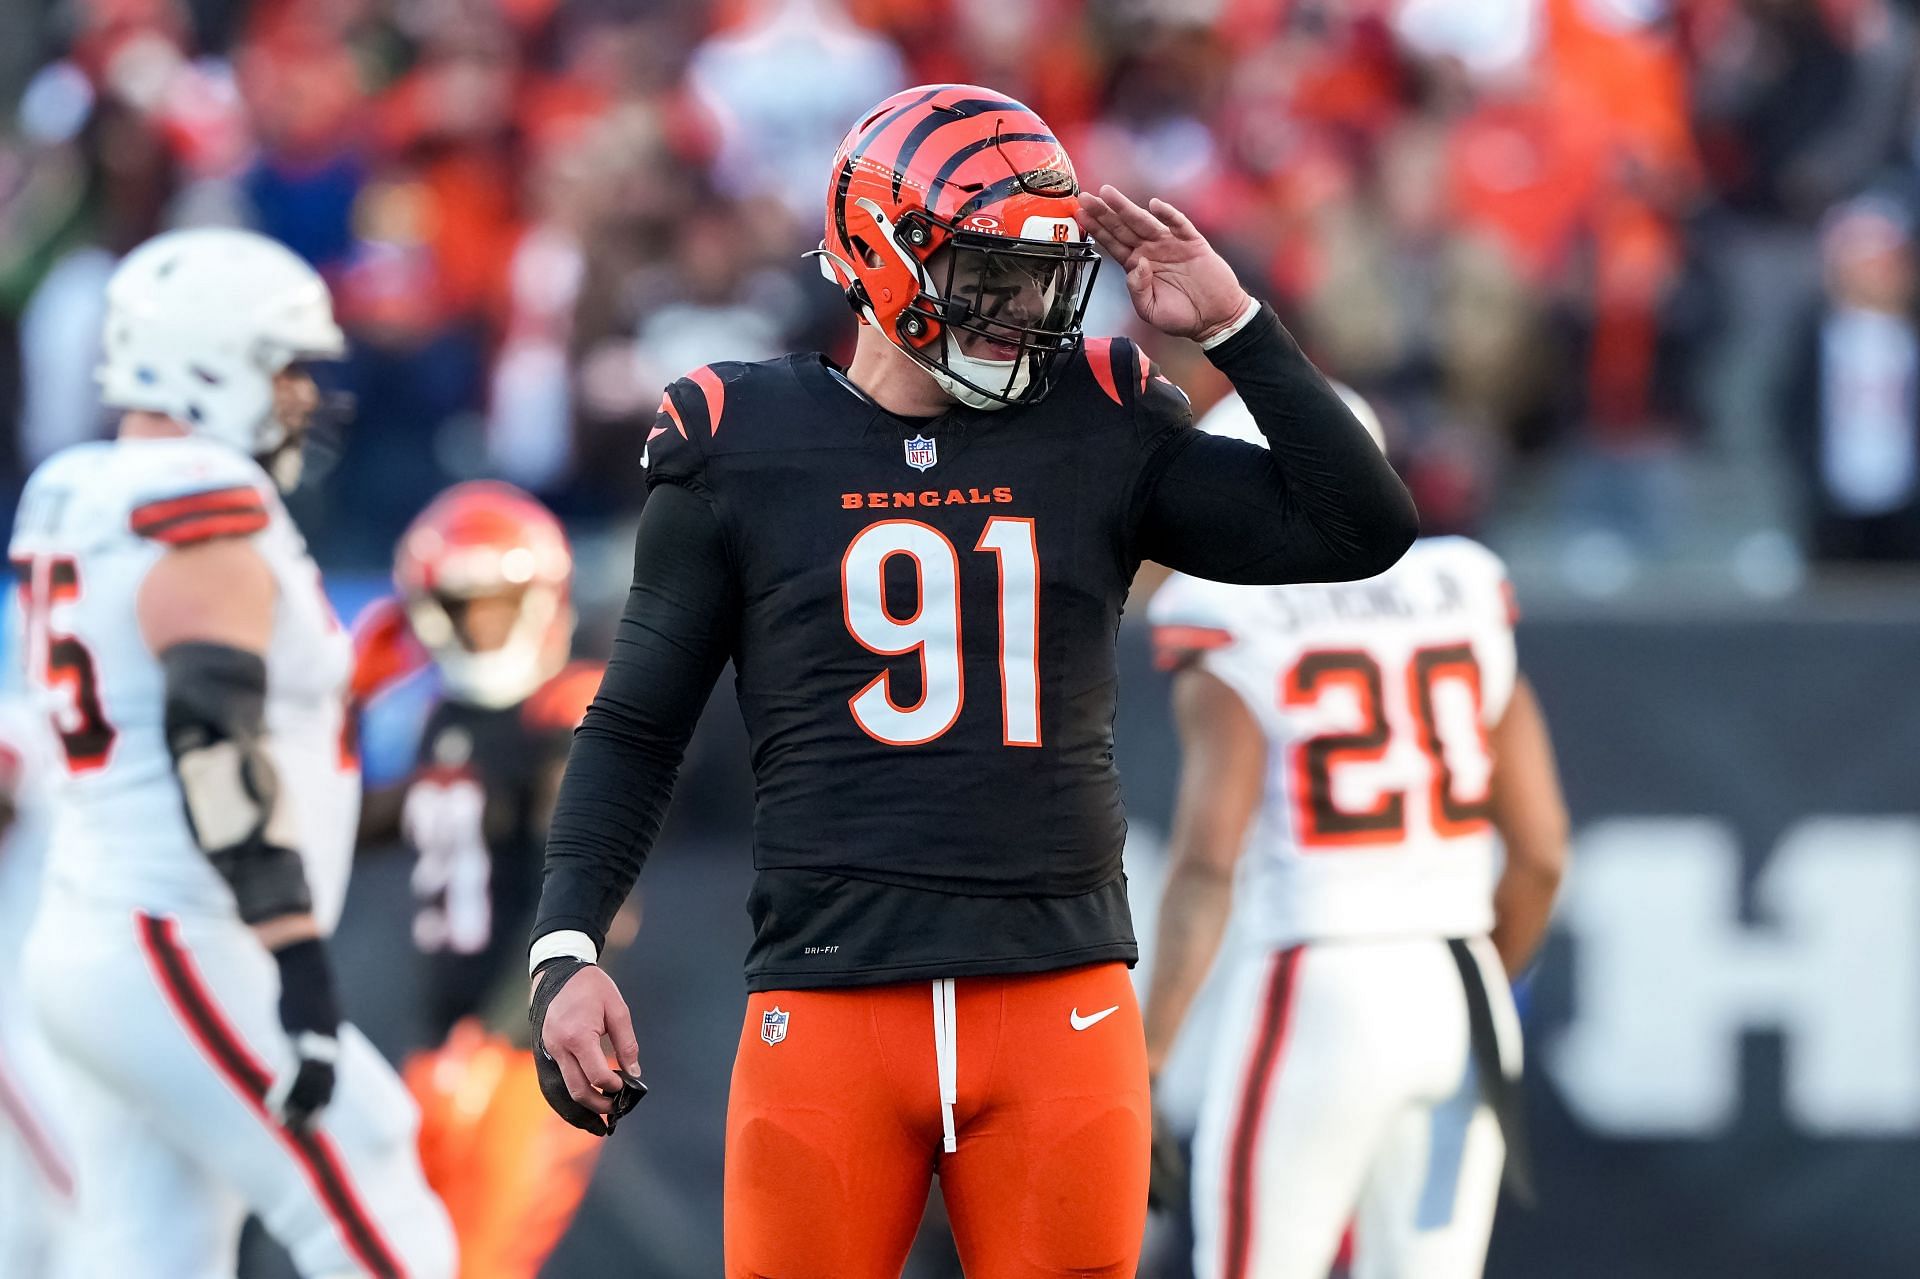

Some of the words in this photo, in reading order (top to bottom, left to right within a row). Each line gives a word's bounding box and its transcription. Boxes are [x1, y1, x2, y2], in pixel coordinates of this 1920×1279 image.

[963, 224, 1005, 236] OAKLEY
[911, 450, 932, 464] NFL
[840, 487, 1013, 509] BENGALS
[841, 516, 1043, 747] 91
[1278, 640, 1495, 848] 20
[804, 945, 840, 955] DRI-FIT
[764, 1024, 782, 1039] NFL
